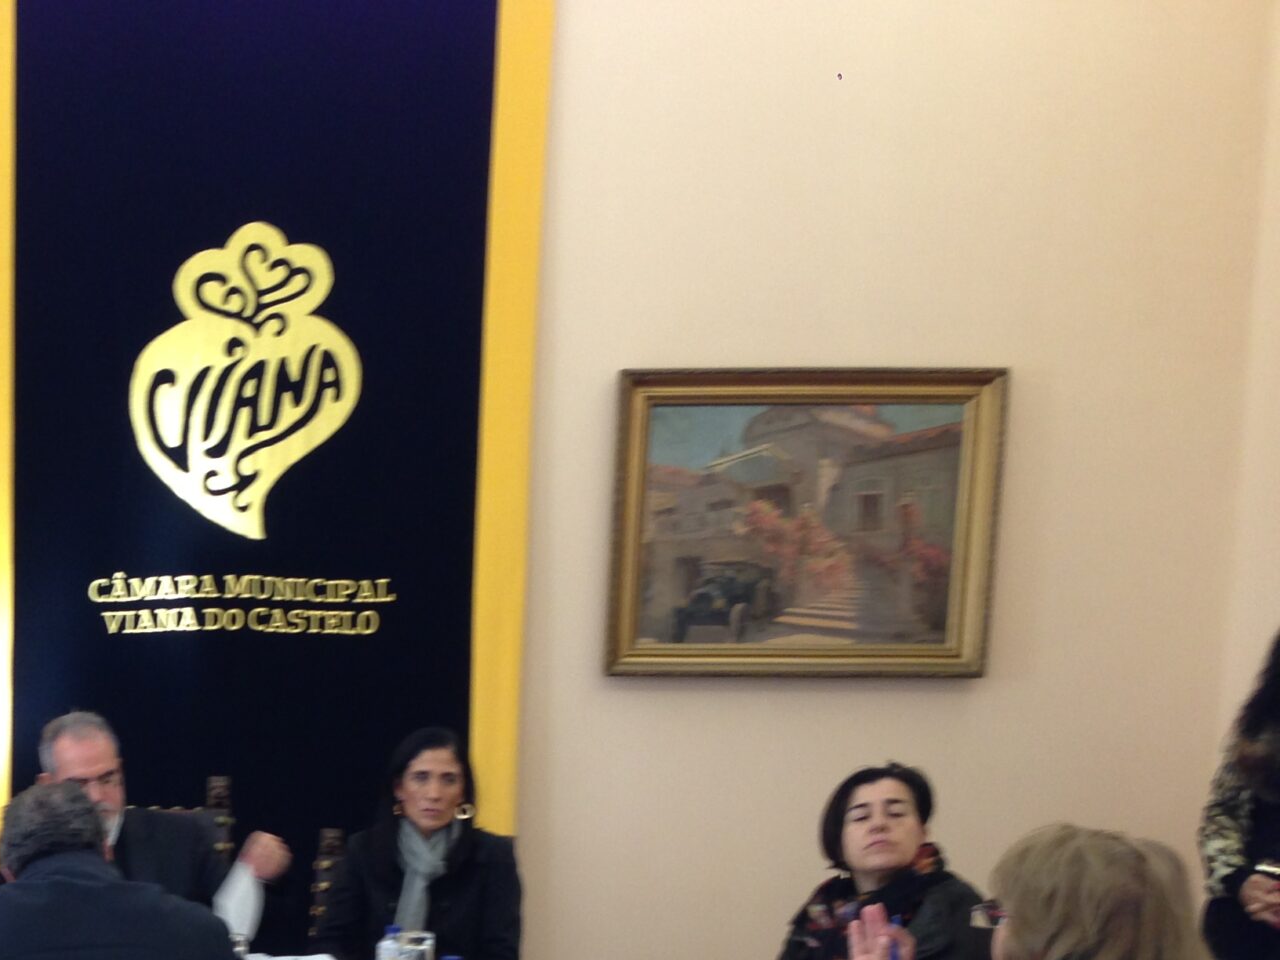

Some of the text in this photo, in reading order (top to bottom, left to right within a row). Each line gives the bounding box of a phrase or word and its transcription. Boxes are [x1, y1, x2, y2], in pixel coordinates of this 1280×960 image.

[145, 338, 342, 473] VIANA
[88, 571, 396, 602] CÂMARA MUNICIPAL
[101, 607, 380, 634] VIANA DO CASTELO
